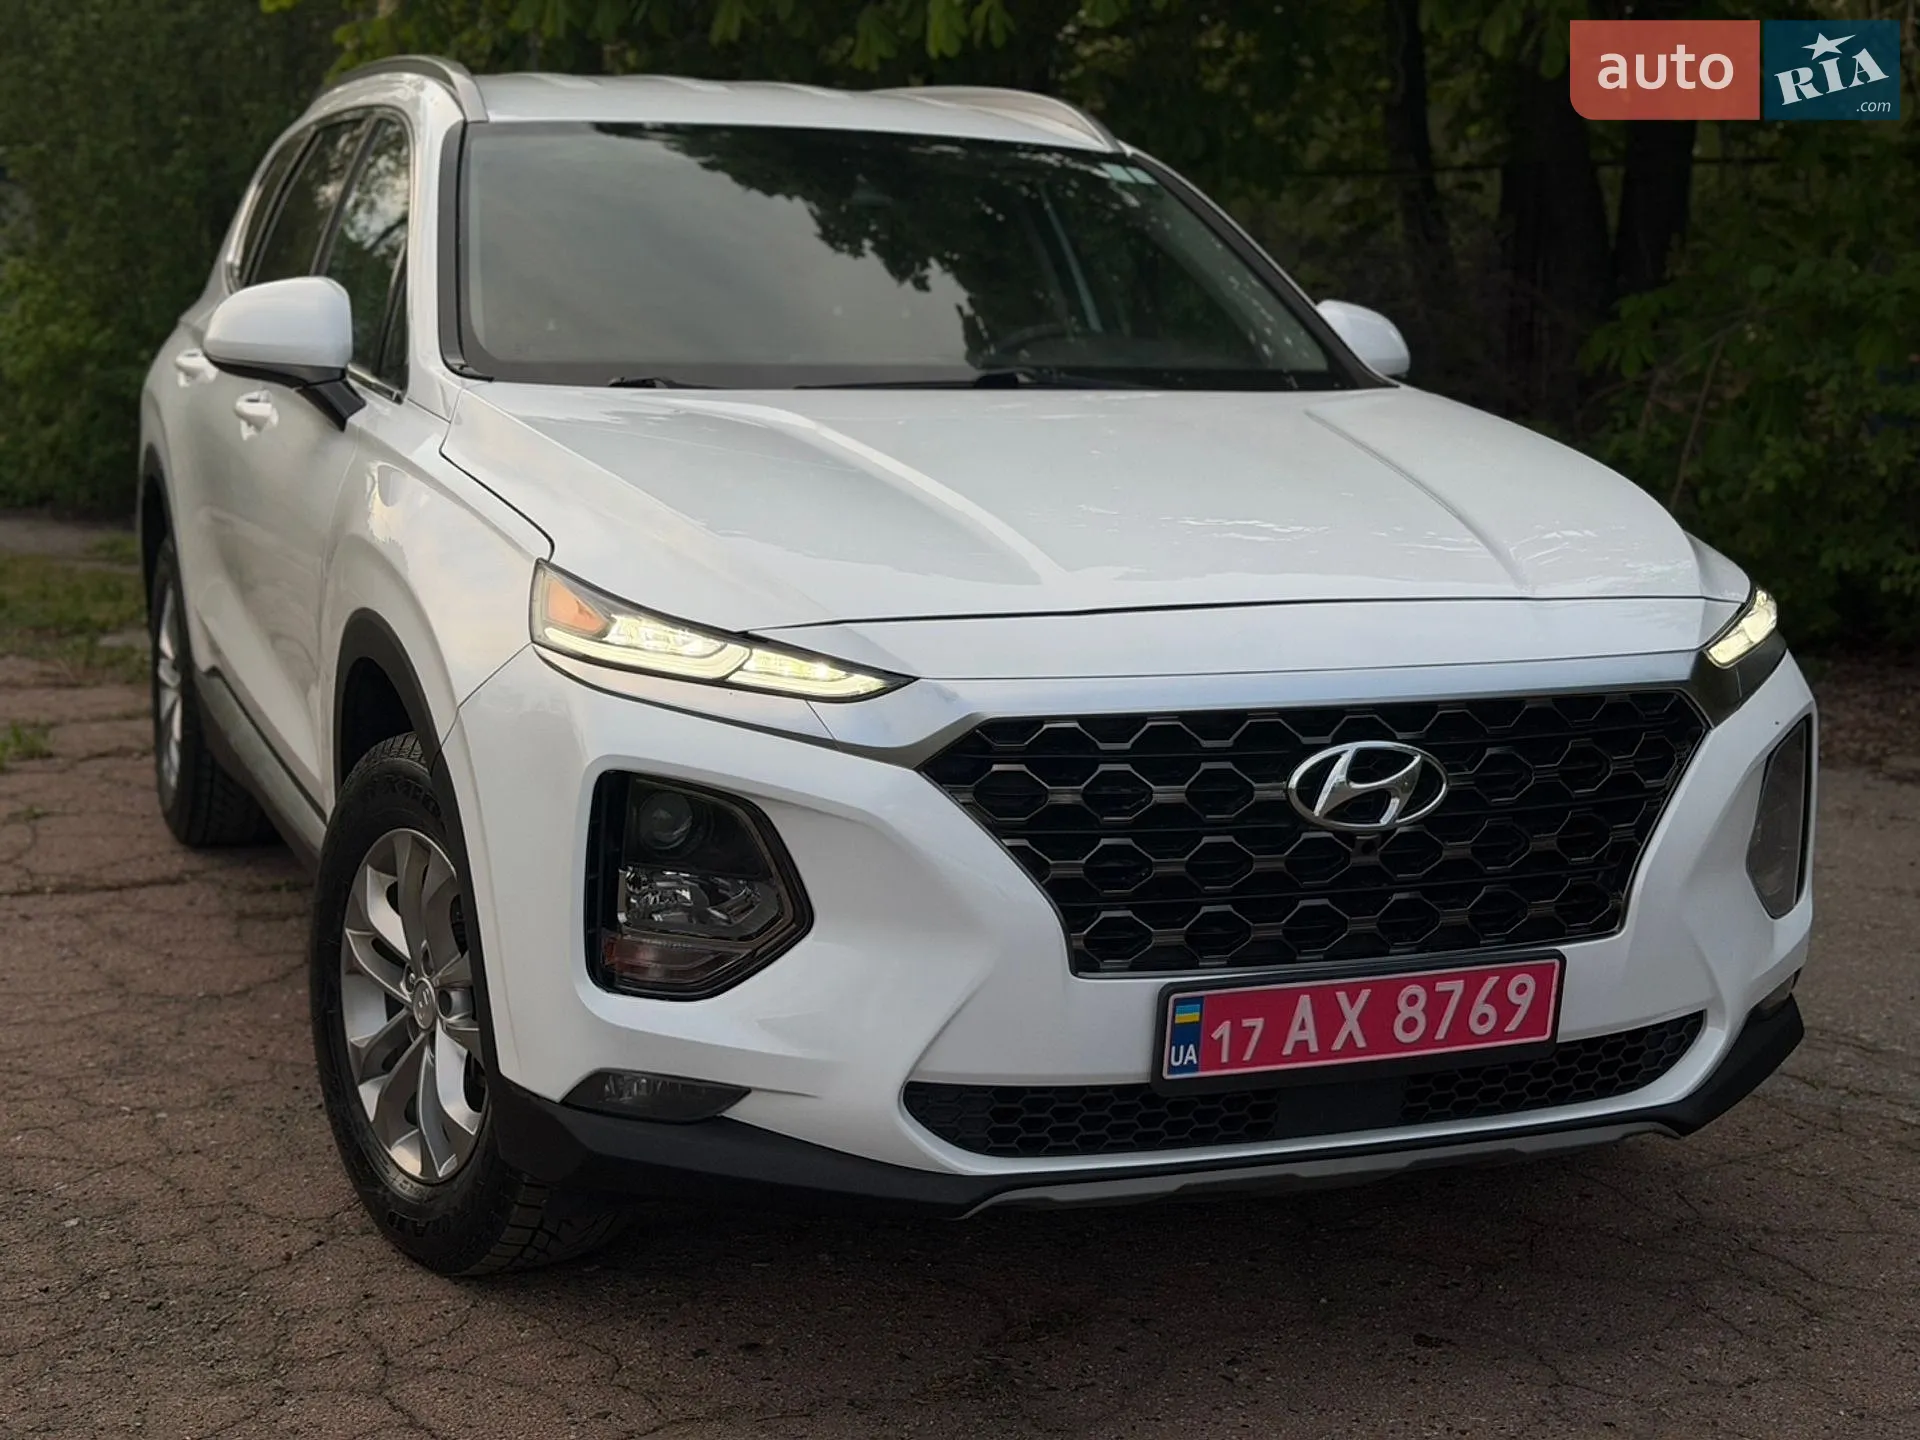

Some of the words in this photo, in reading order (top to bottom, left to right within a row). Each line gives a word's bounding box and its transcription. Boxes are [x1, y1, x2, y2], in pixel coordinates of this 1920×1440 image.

[1211, 1017, 1265, 1063] 17
[1282, 988, 1371, 1056] AX
[1393, 973, 1536, 1044] 8769
[1171, 1044, 1197, 1067] UA
